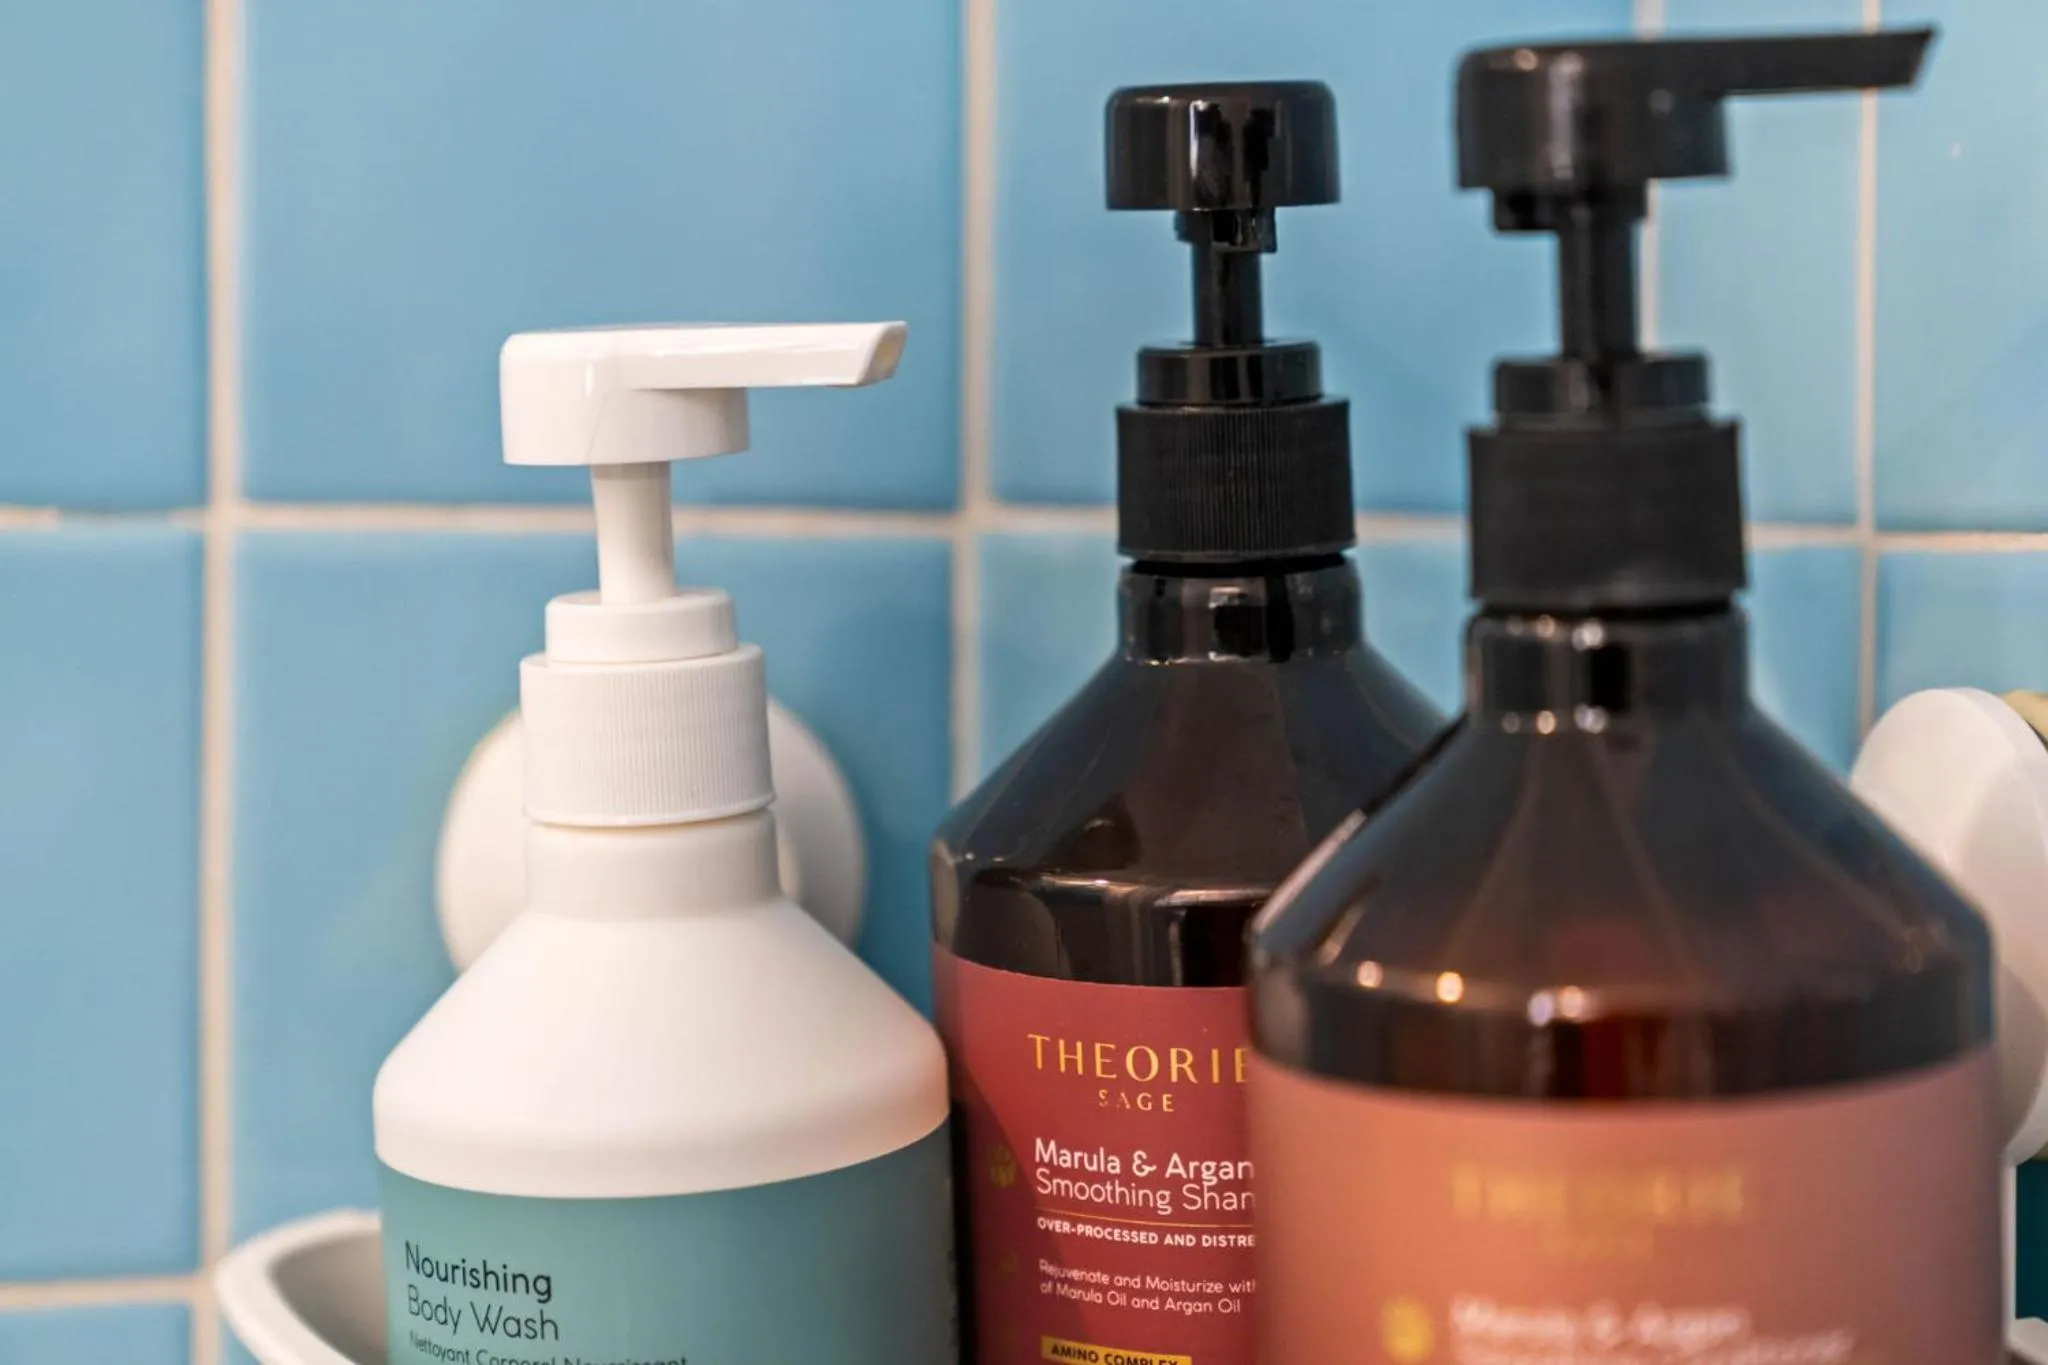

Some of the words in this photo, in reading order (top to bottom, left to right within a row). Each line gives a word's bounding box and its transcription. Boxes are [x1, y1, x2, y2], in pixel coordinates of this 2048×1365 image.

[1098, 1089, 1174, 1112] SAGE
[1035, 1137, 1121, 1175] Marula
[1132, 1151, 1157, 1177] &
[1165, 1153, 1254, 1185] Argan
[1036, 1168, 1172, 1215] Smoothing
[1037, 1216, 1158, 1245] OVER-PROCESSED
[1164, 1234, 1196, 1247] AND
[405, 1241, 552, 1304] Nourishing
[1039, 1259, 1111, 1285] Rejuvenate
[1114, 1275, 1141, 1289] and
[1146, 1275, 1224, 1294] Moisturize
[408, 1284, 461, 1336] Body
[470, 1301, 559, 1341] Wash
[1040, 1281, 1053, 1294] of
[1056, 1283, 1103, 1304] Marula
[1107, 1290, 1127, 1307] Oil
[1131, 1297, 1160, 1310] and
[1164, 1297, 1213, 1315] Argan
[1218, 1298, 1241, 1313] Oil
[1051, 1344, 1099, 1363] AMINO
